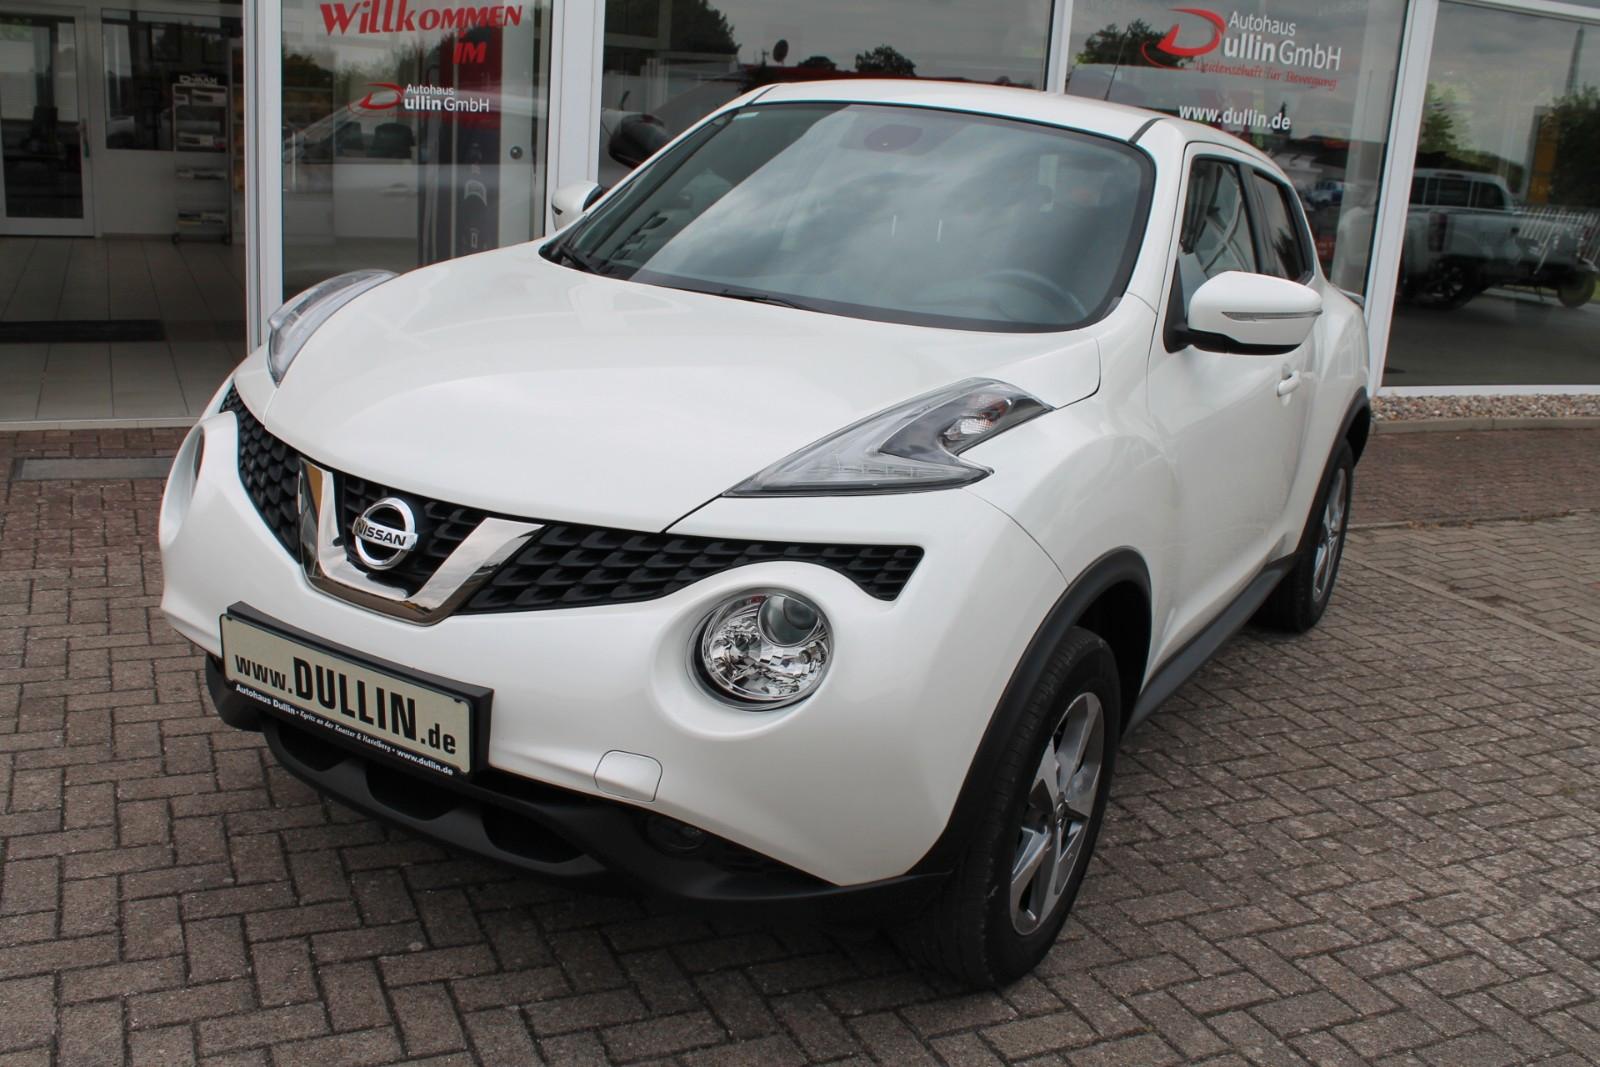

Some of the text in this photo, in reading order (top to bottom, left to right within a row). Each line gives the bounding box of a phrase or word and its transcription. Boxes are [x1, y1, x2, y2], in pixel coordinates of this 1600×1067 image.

[1229, 11, 1296, 36] Autohaus
[1279, 40, 1341, 71] GmbH
[406, 83, 454, 96] Autohaus
[443, 98, 490, 113] GmbH
[1179, 105, 1291, 130] www.dullin.de
[355, 518, 407, 547] NISSAN
[235, 654, 457, 755] www.DULLIN.de
[236, 683, 272, 705] Autohaus
[273, 698, 296, 715] Dullin
[396, 748, 453, 776] www.dullin.de
